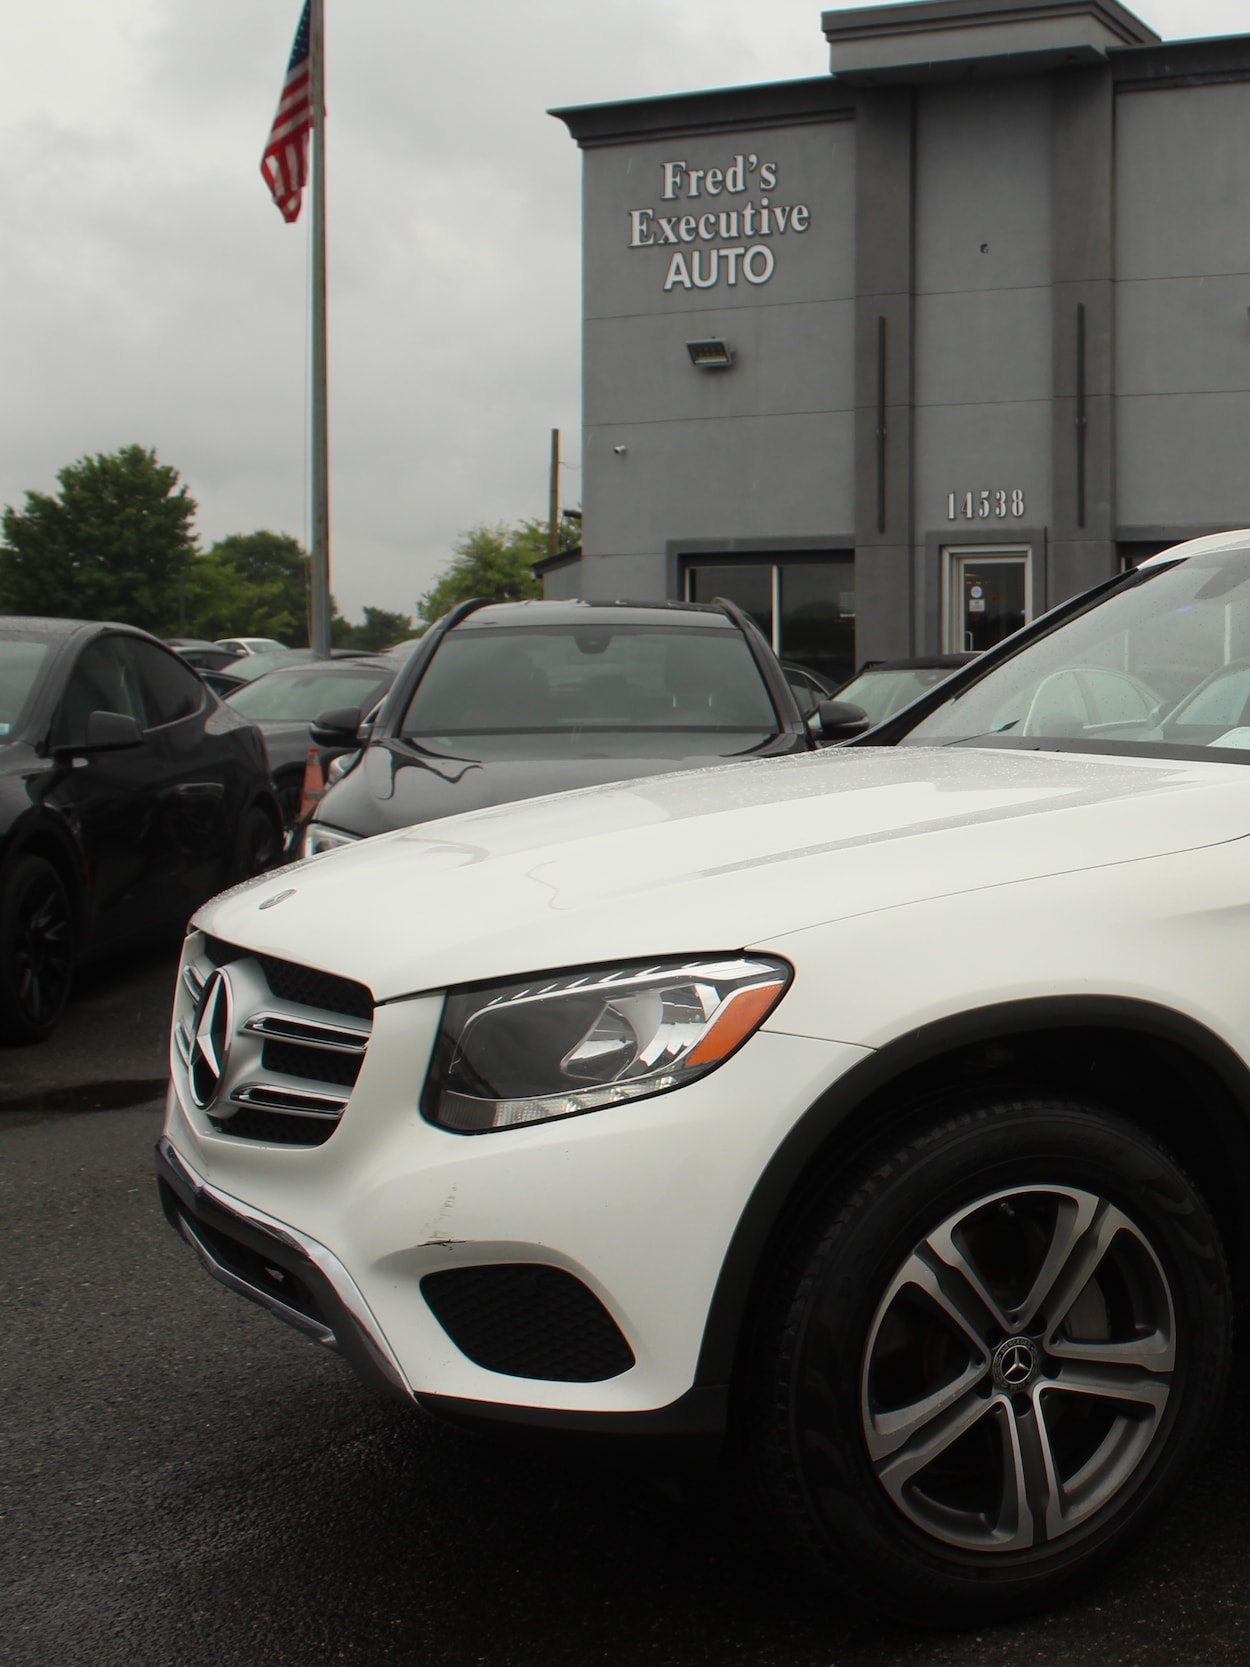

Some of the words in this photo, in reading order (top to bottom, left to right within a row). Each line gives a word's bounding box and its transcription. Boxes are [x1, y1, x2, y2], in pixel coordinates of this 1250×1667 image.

[661, 153, 777, 199] Fred's
[628, 198, 810, 247] Executive
[664, 244, 775, 290] AUTO
[948, 489, 1025, 520] 14538
